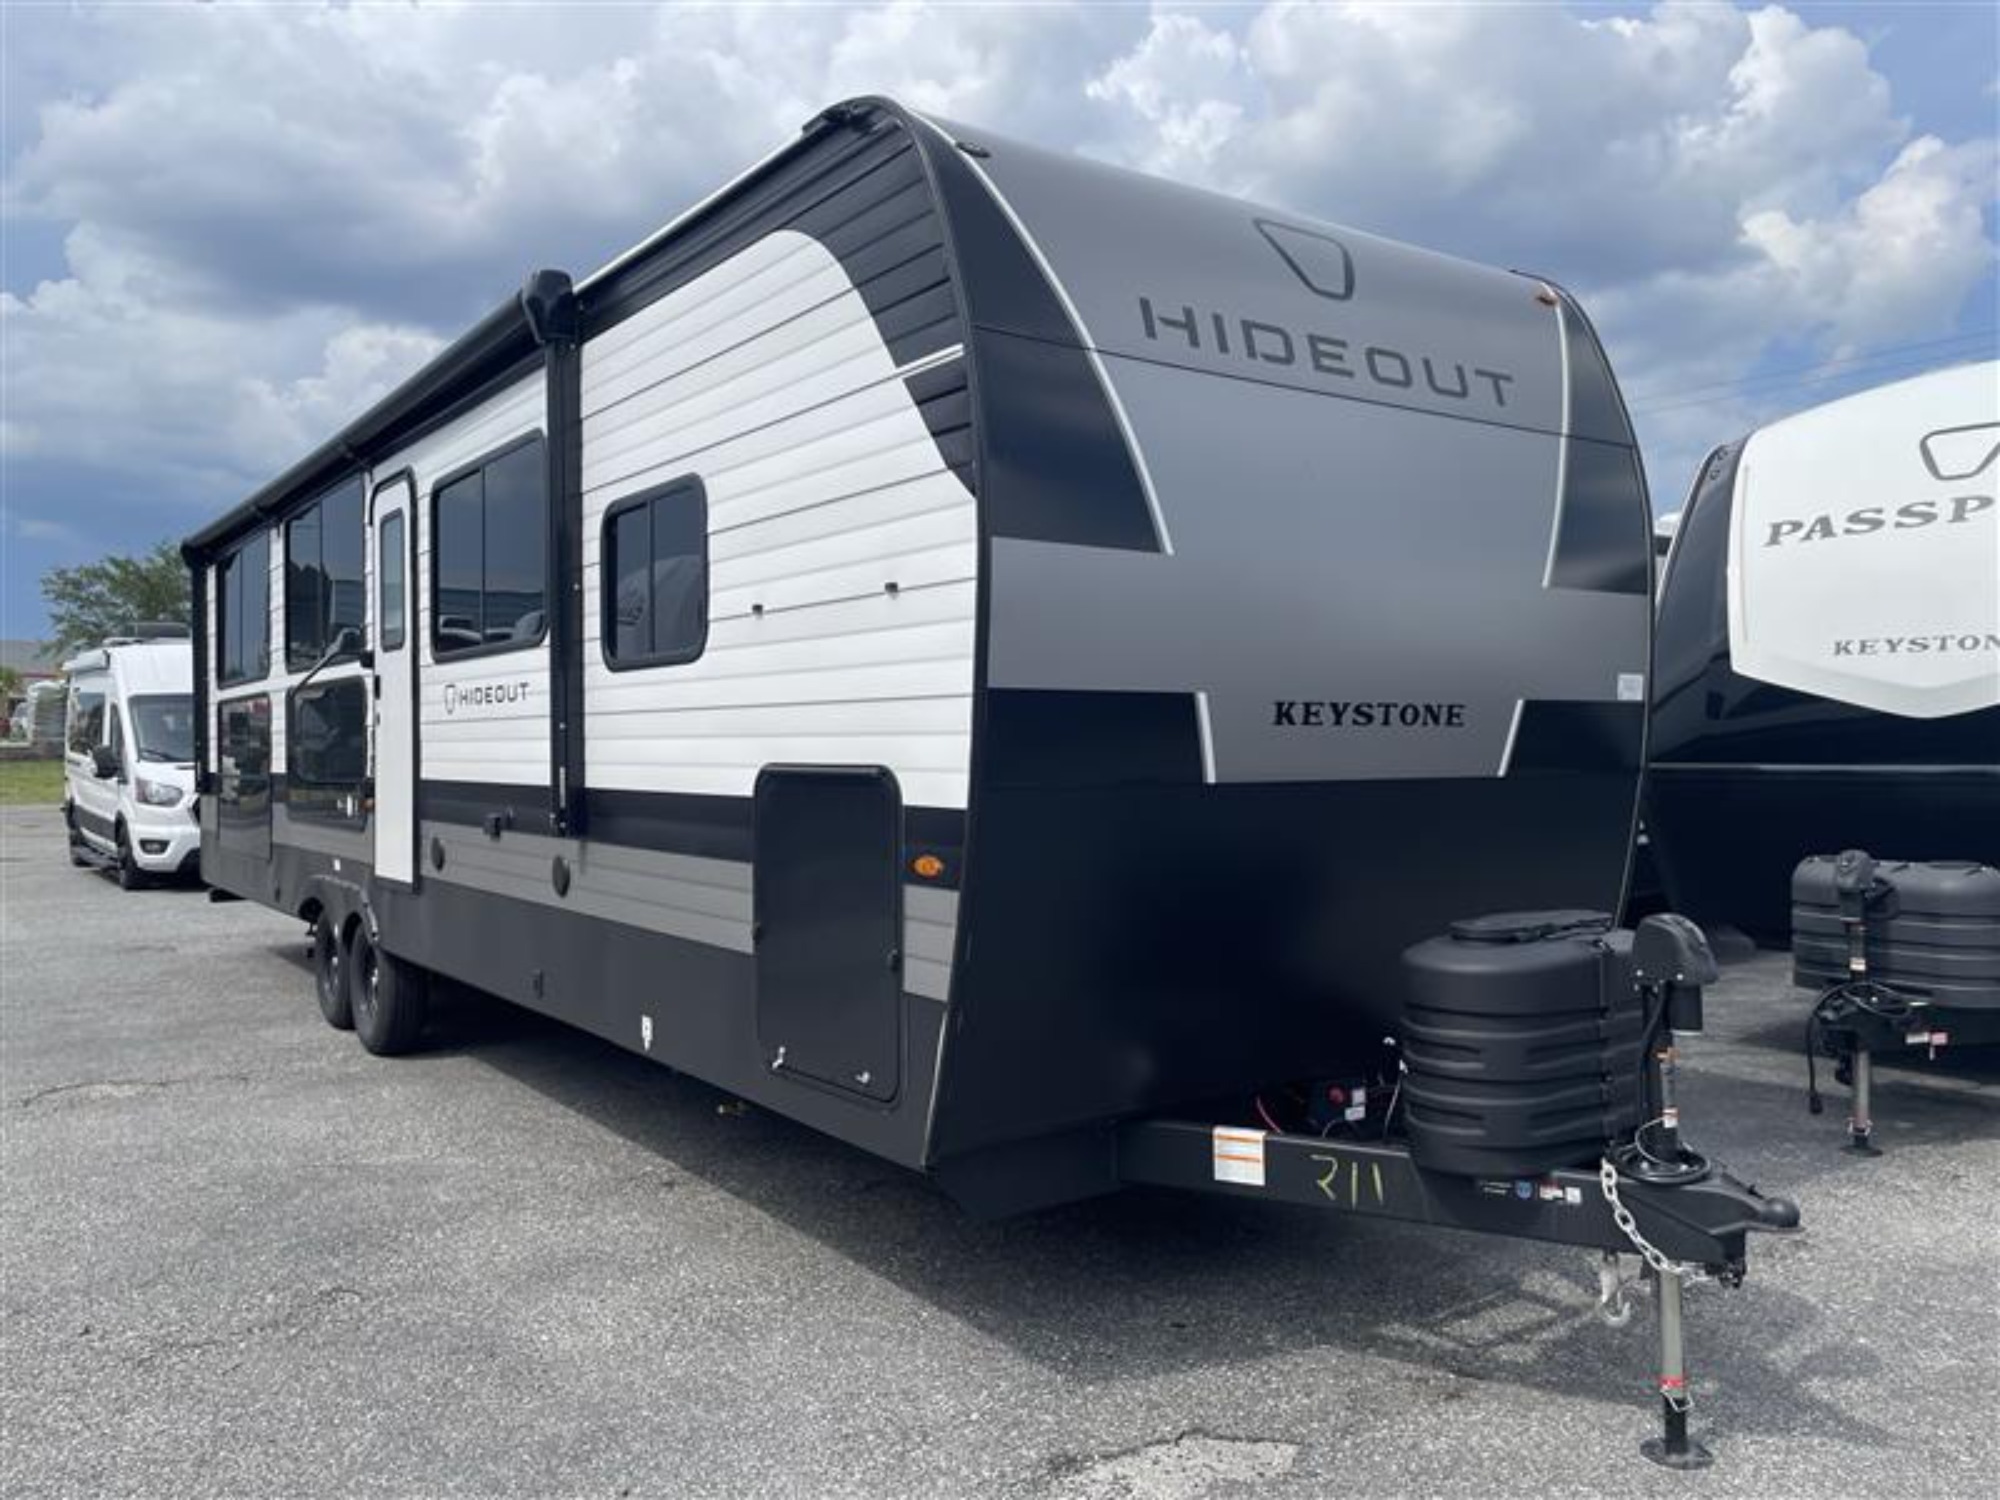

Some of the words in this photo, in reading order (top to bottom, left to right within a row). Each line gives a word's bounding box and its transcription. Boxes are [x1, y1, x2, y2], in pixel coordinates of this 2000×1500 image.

[1139, 297, 1514, 406] HIDEOUT
[1763, 495, 1995, 547] PASSP
[458, 682, 530, 705] HIDEOUT
[1273, 701, 1466, 728] KEYSTONE
